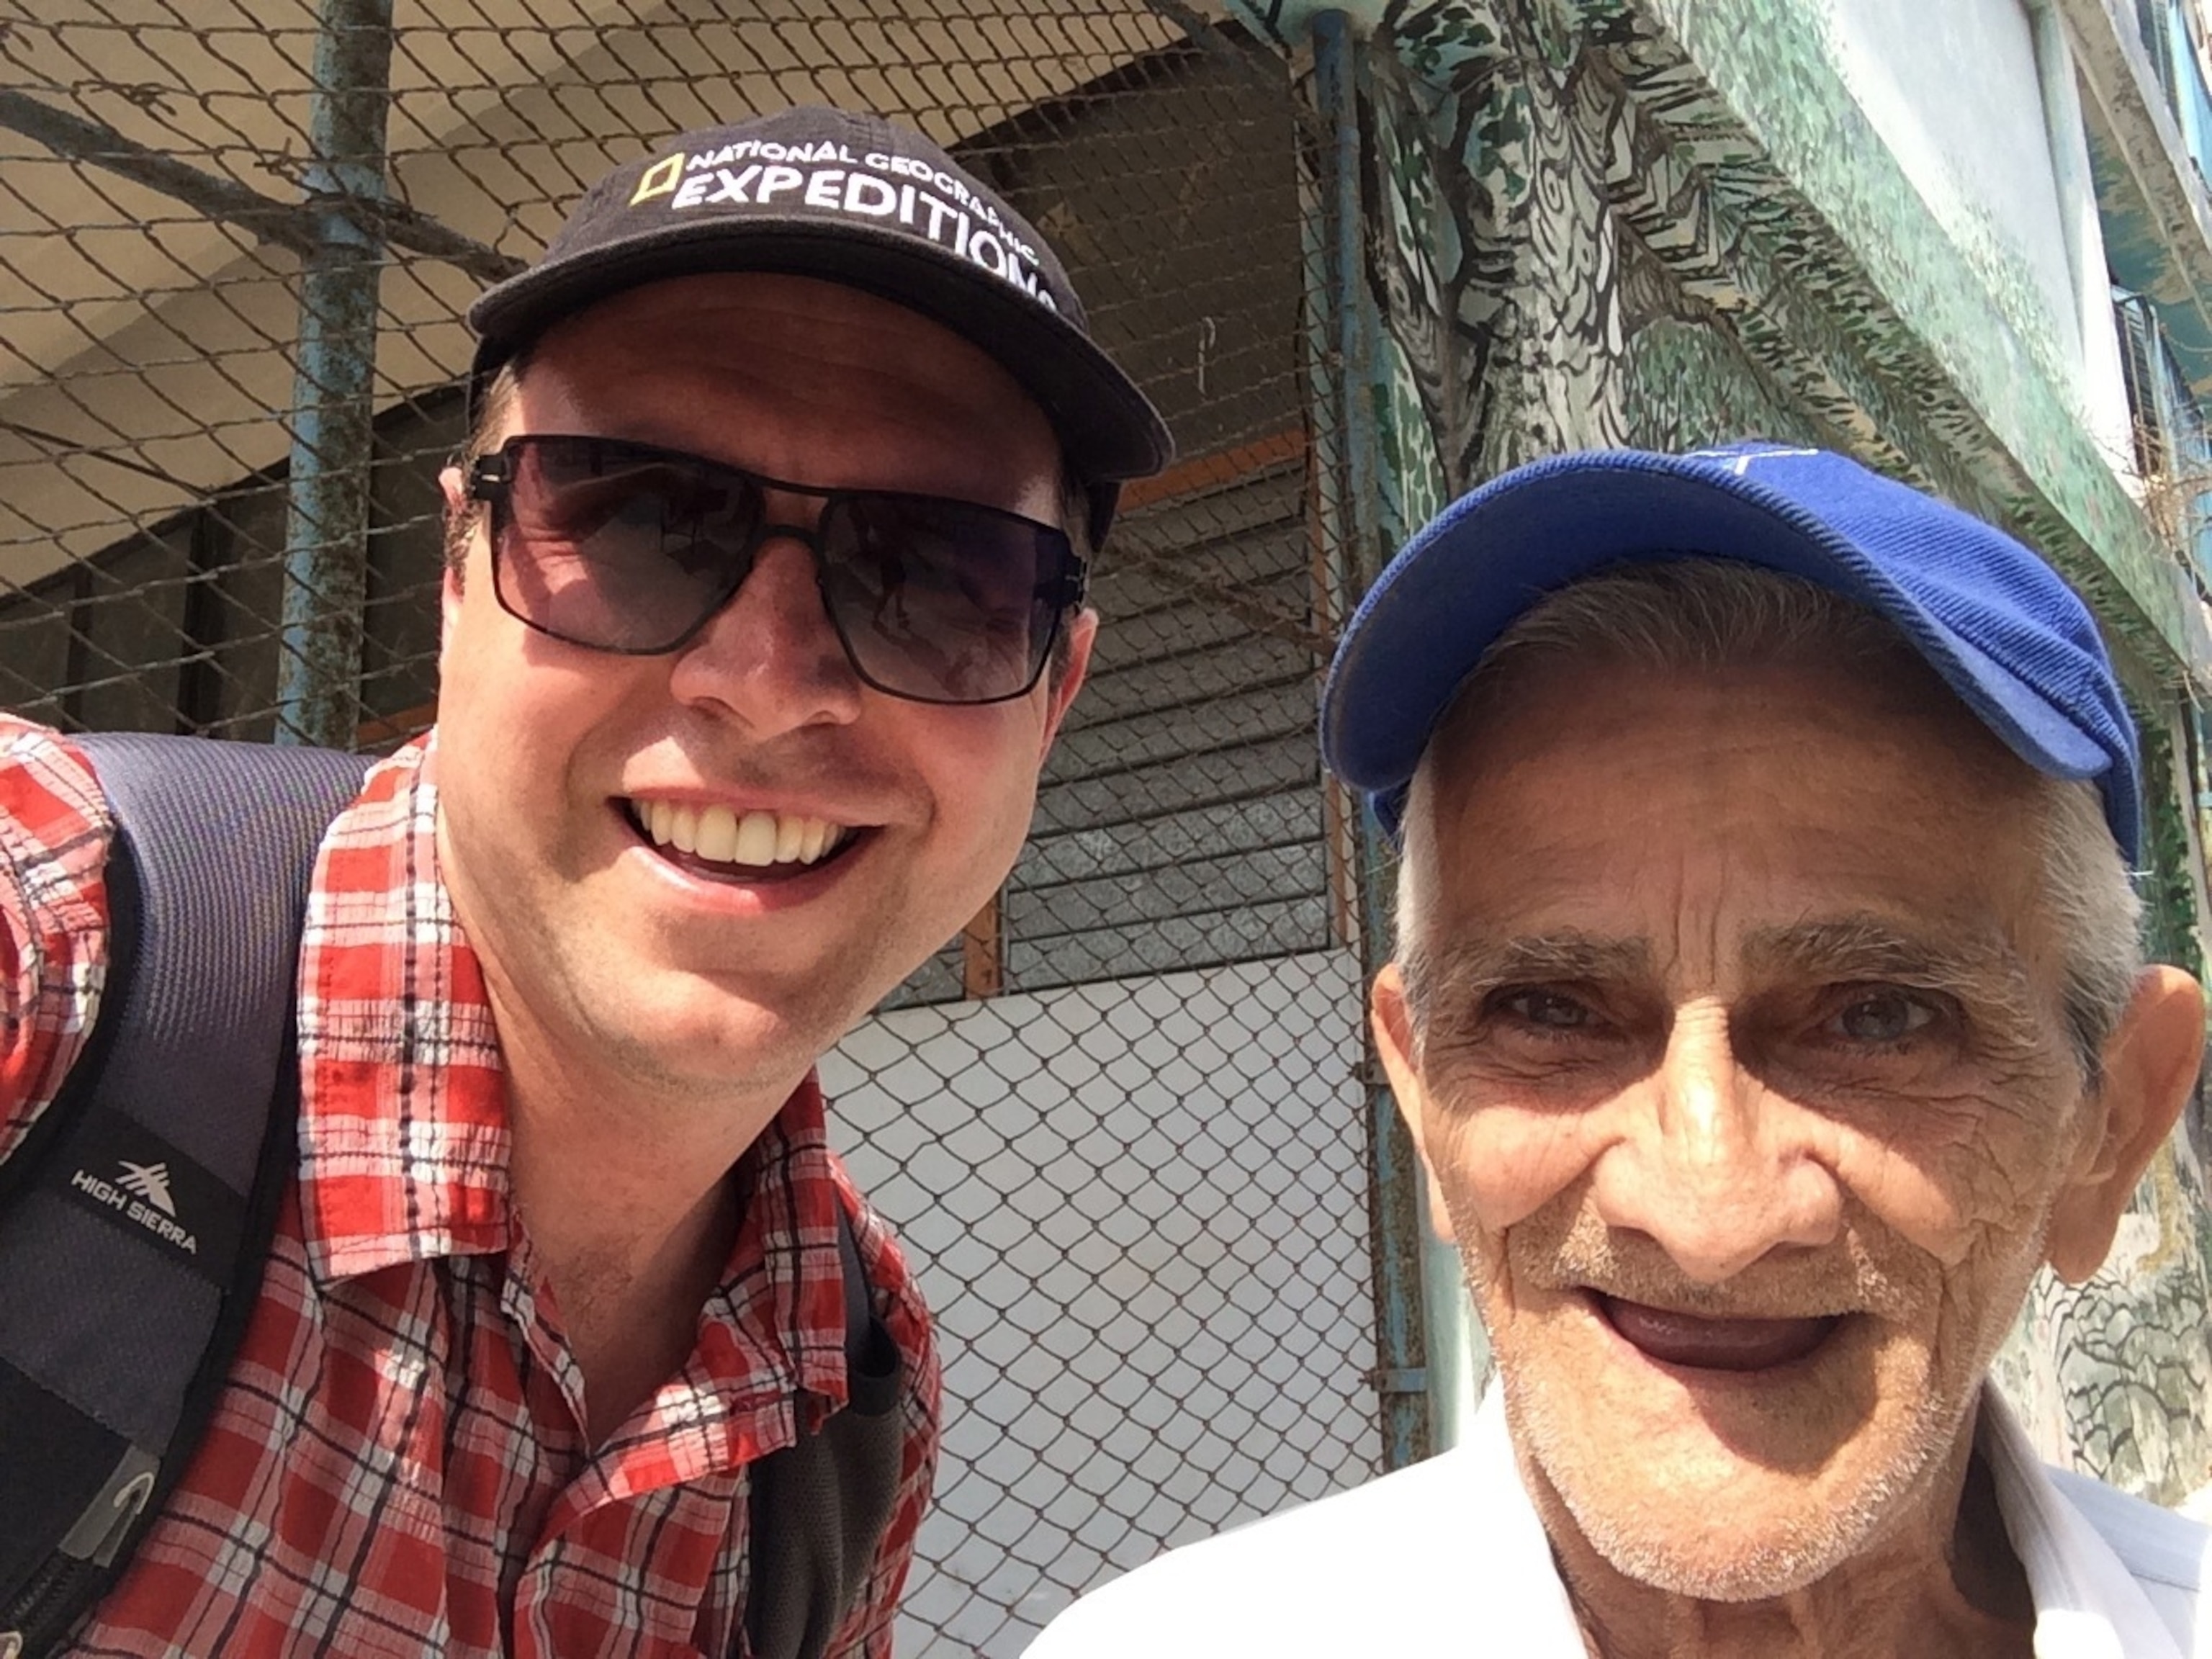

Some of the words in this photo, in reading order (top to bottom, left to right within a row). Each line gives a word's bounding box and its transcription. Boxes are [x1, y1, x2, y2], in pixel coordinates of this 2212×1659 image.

[685, 140, 858, 171] NATIONAL
[865, 153, 1039, 266] GEOGRAPHIC
[71, 1169, 127, 1210] HIGH
[127, 1200, 196, 1254] SIERRA
